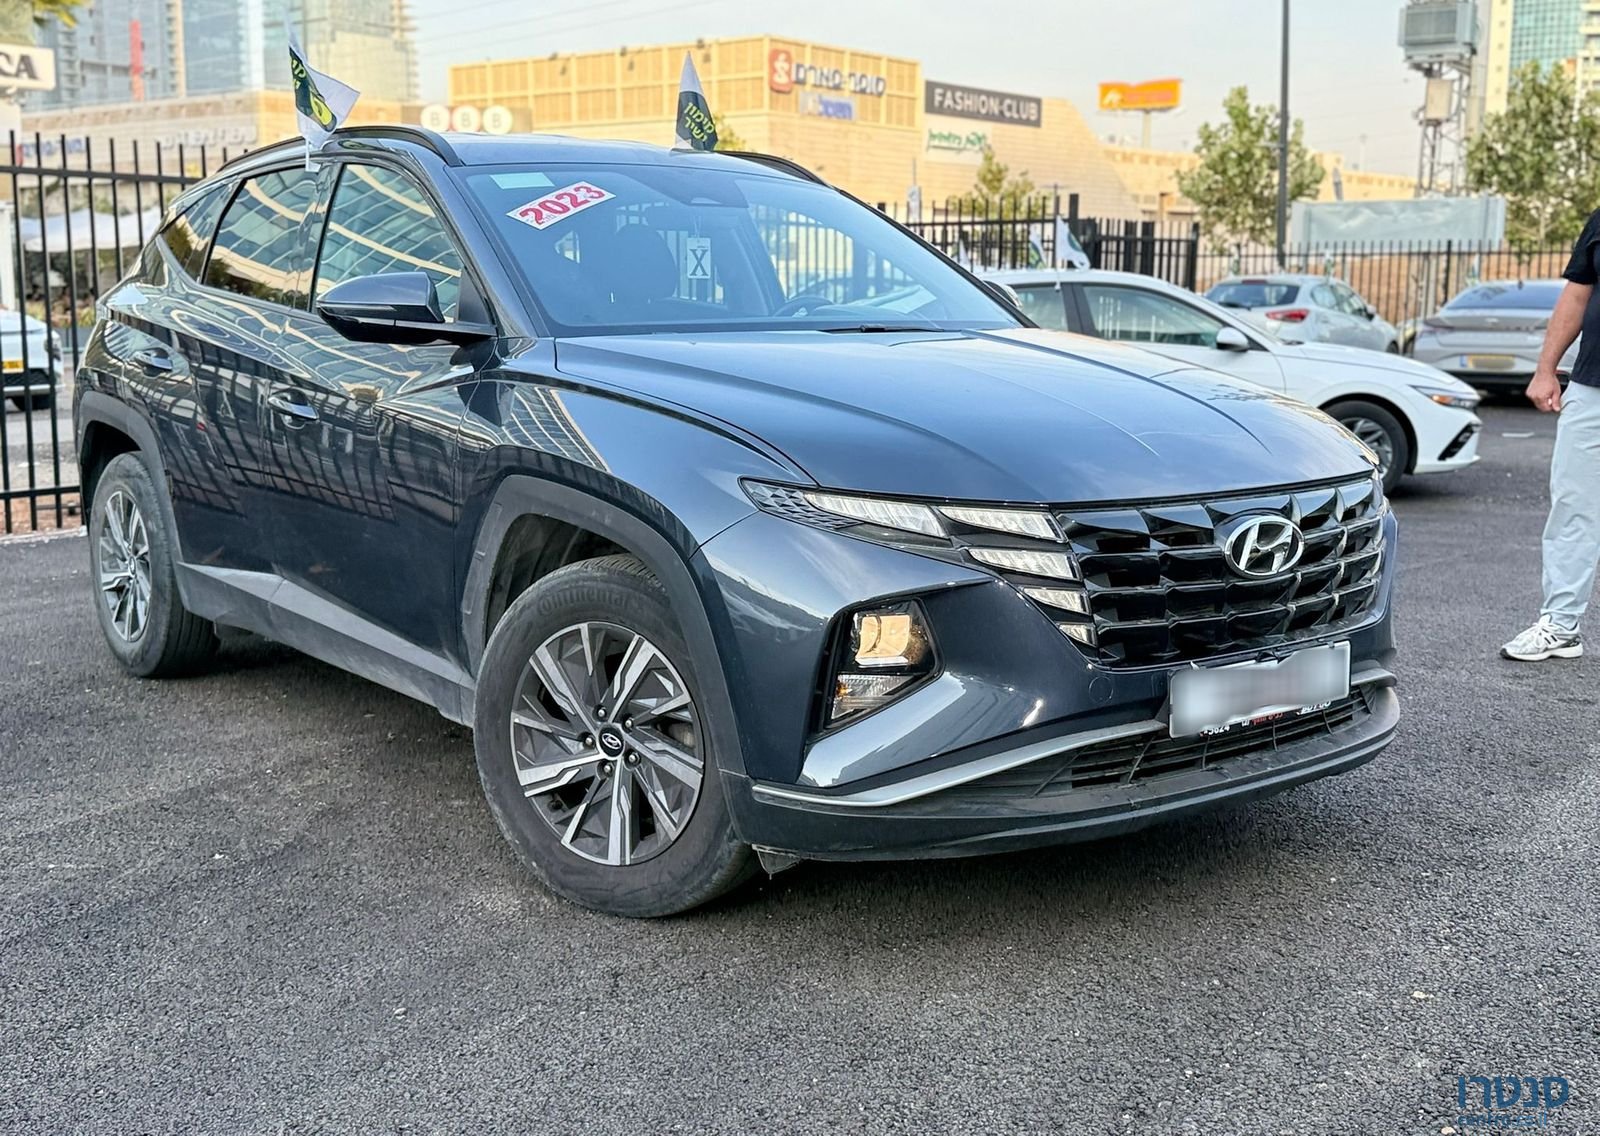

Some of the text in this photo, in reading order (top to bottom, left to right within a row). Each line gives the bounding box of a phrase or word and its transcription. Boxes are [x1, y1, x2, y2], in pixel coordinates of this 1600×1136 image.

[684, 102, 714, 133] מימון
[684, 116, 708, 142] ישיר
[519, 185, 606, 226] 2023
